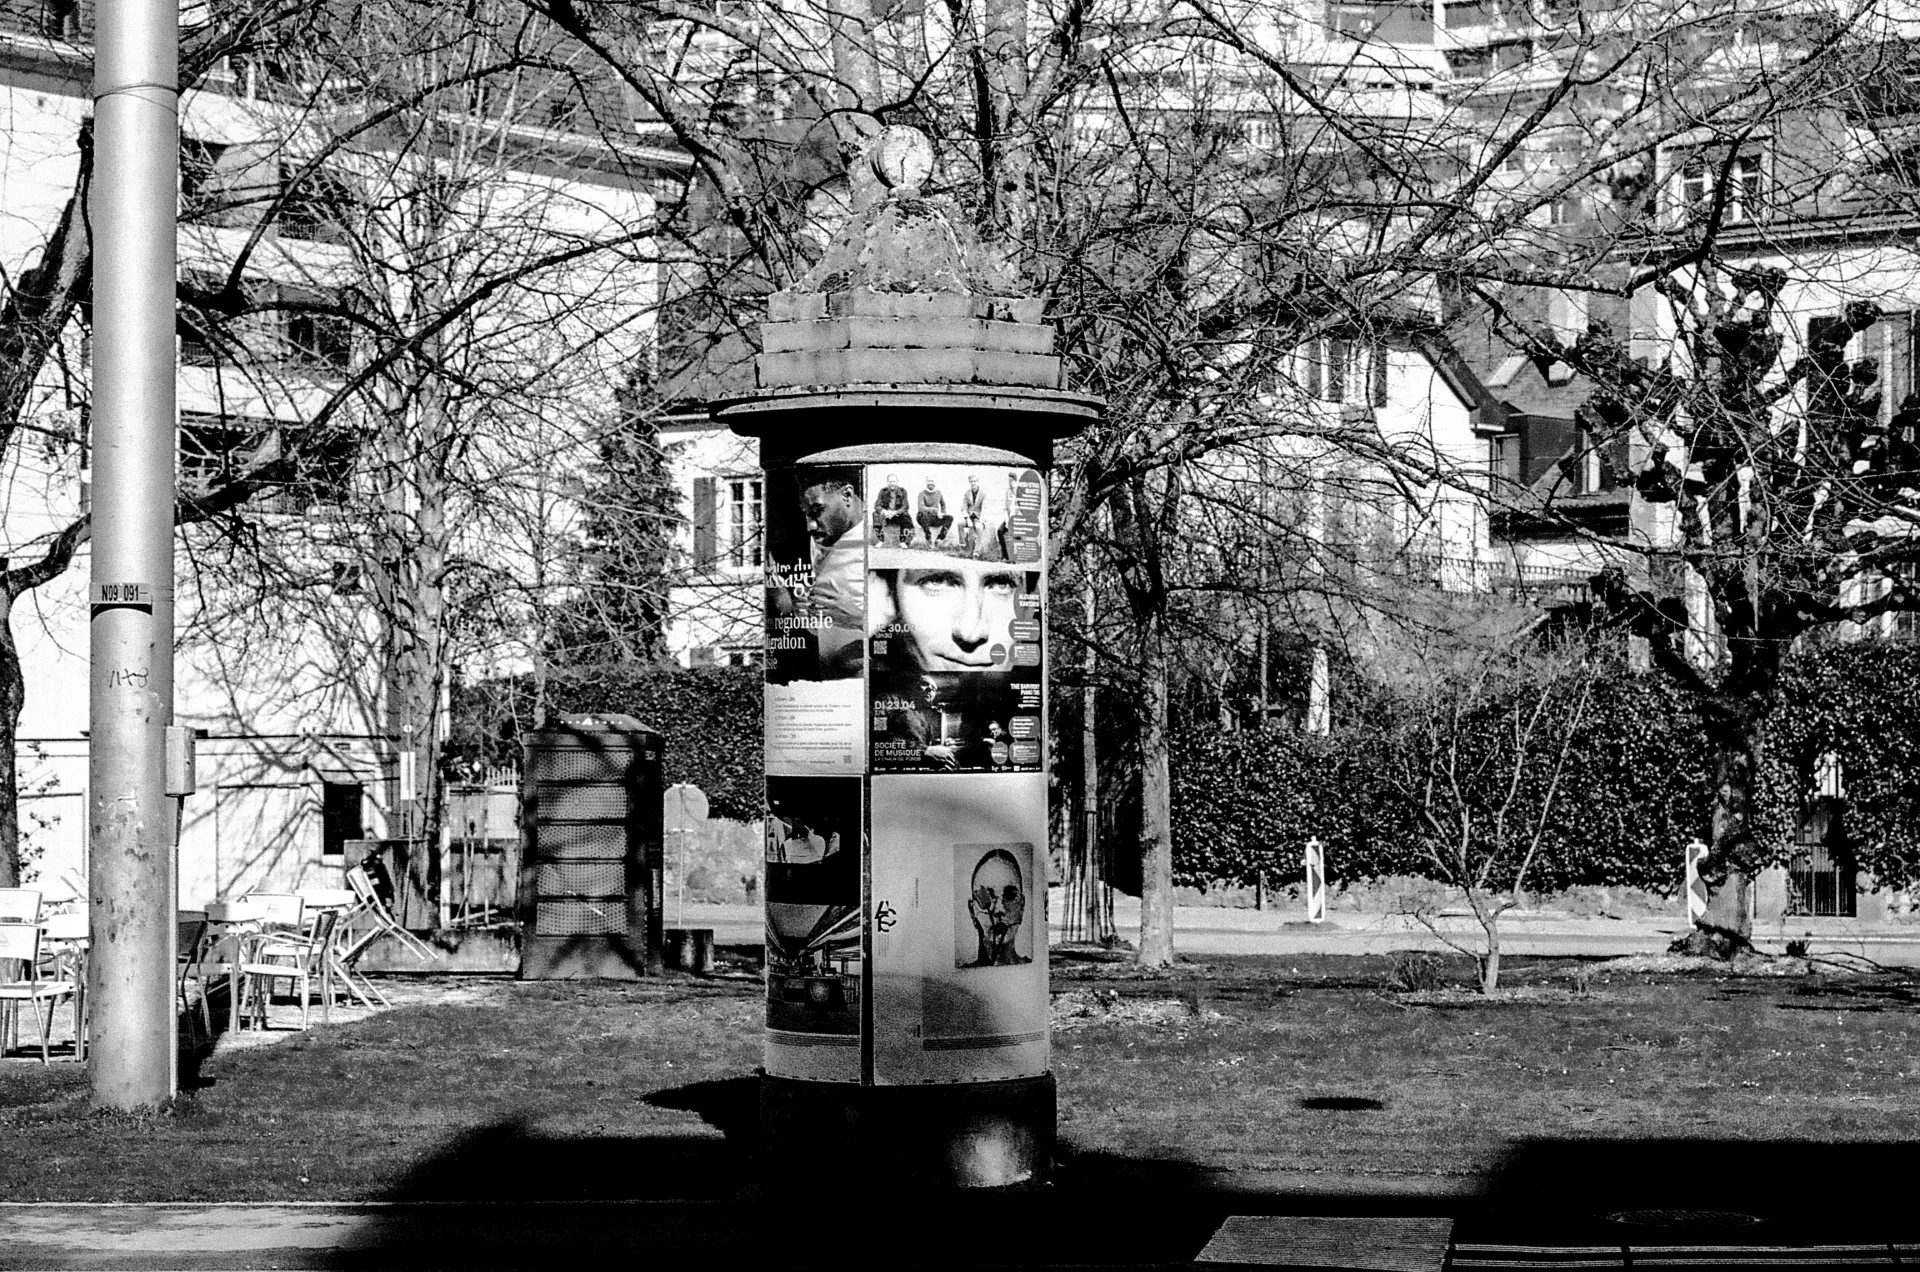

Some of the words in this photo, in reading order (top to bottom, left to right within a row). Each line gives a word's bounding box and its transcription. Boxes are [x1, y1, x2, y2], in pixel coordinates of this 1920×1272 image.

[794, 558, 812, 571] du
[101, 584, 118, 602] N09
[774, 608, 833, 634] régionale
[874, 700, 885, 710] DI
[887, 700, 917, 710] 23.04
[874, 749, 885, 757] DE
[885, 749, 921, 757] MUSIQUE
